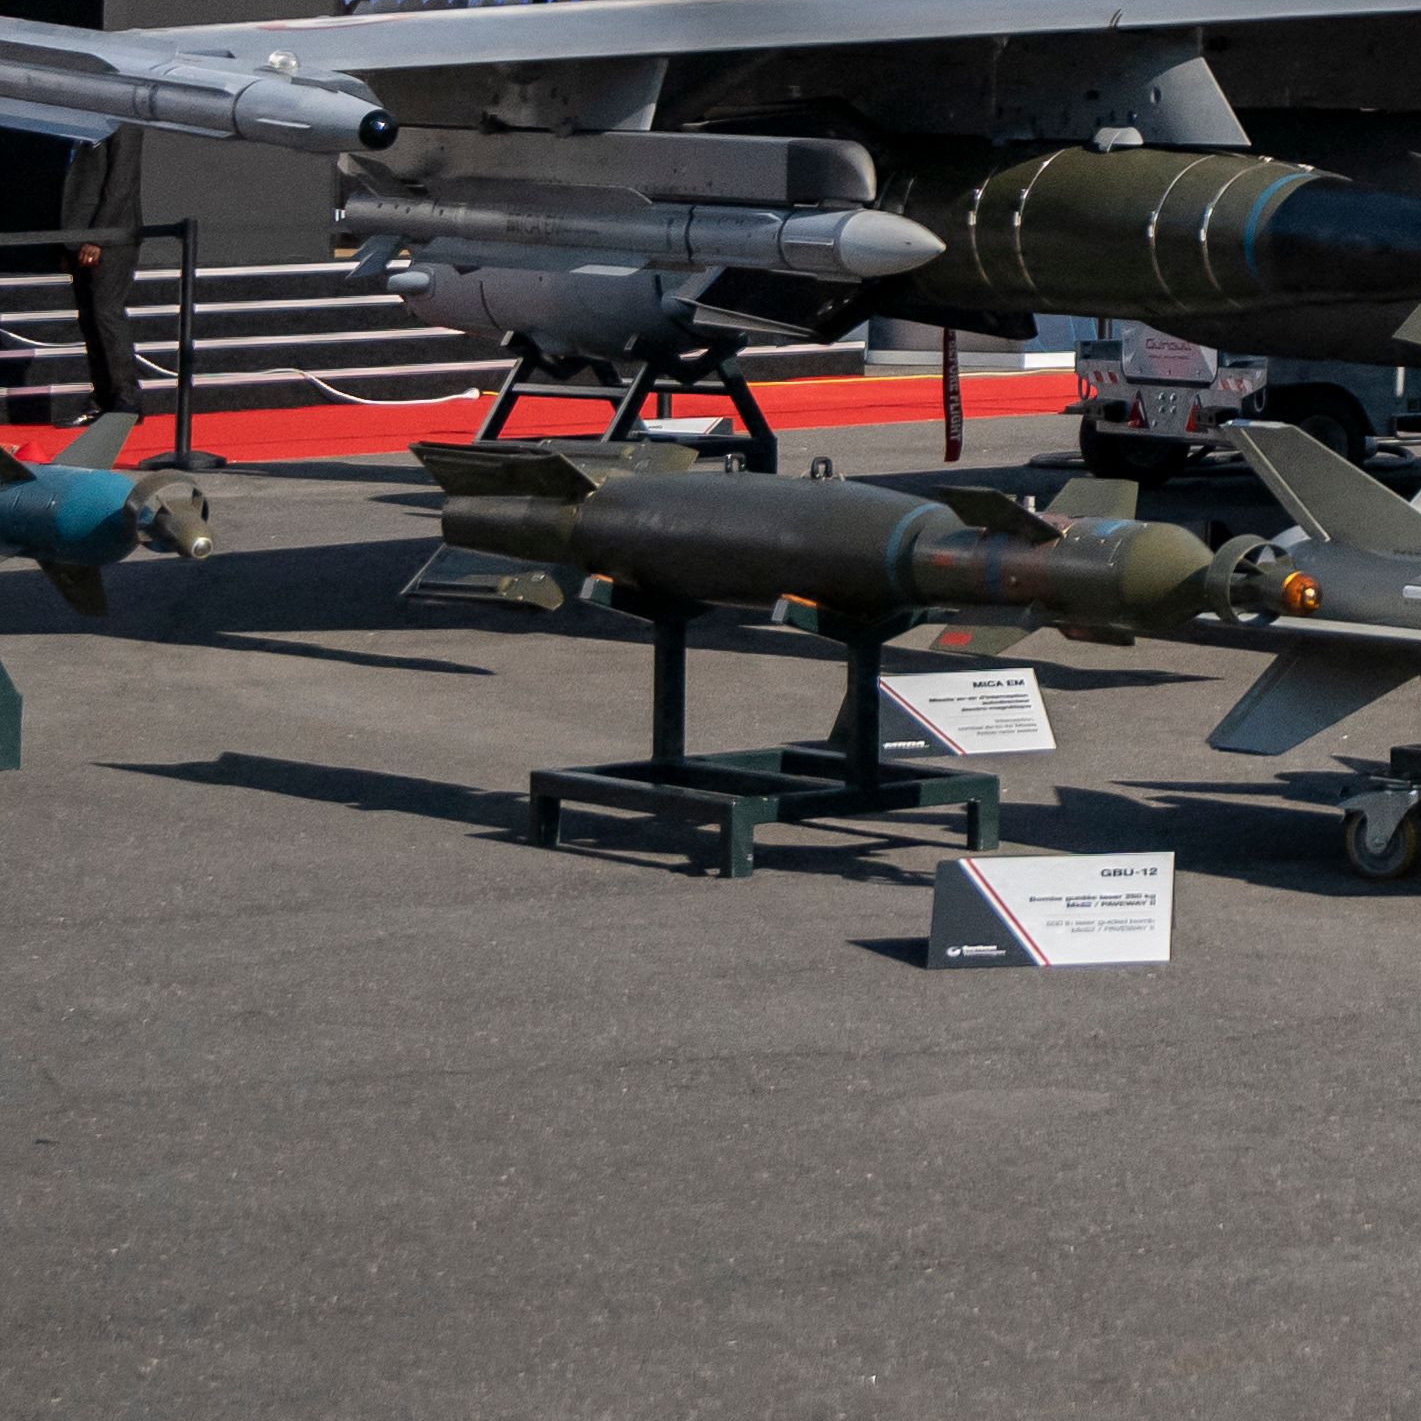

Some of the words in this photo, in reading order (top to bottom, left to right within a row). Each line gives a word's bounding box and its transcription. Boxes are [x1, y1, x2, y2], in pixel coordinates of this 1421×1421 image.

[949, 395, 962, 441] FLIGHT
[972, 680, 1003, 688] MICA
[1100, 867, 1158, 877] GBU-12
